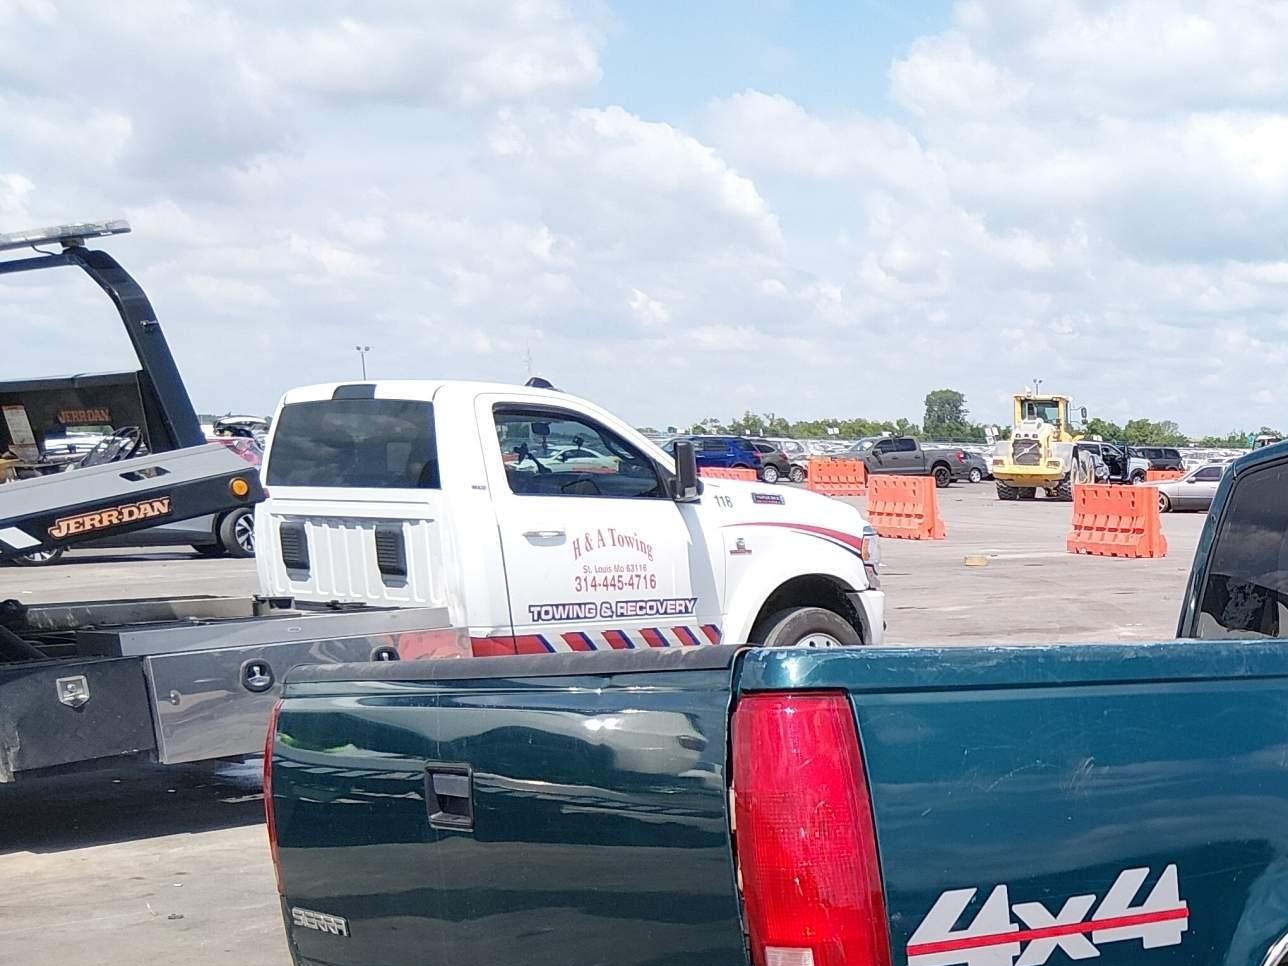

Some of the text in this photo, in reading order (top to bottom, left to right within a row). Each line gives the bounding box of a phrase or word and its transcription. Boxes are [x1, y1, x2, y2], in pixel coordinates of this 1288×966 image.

[49, 497, 171, 538] JERR-DAN
[572, 528, 654, 562] H & A Towing
[594, 564, 612, 574] Louis
[575, 574, 657, 593] 314-445-4716
[529, 598, 698, 622] TOWING & RECOVERY
[292, 906, 347, 937] SIERRA
